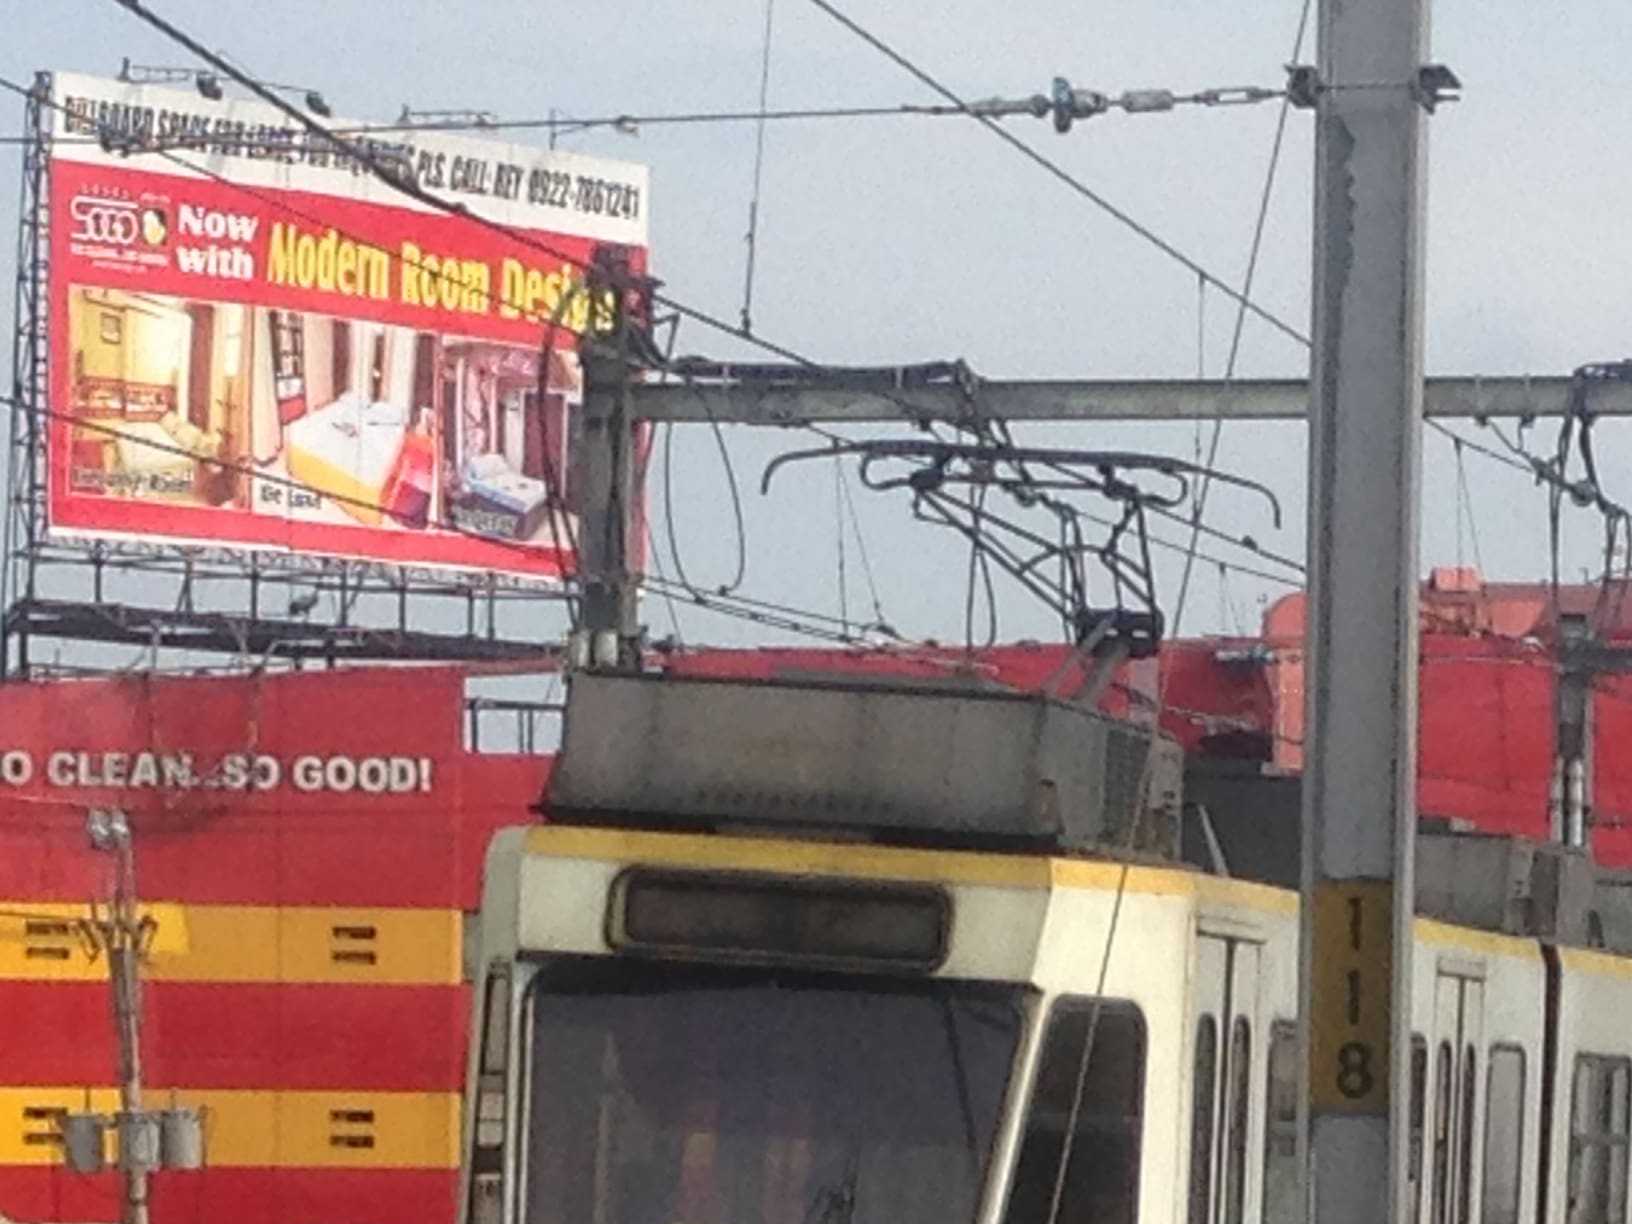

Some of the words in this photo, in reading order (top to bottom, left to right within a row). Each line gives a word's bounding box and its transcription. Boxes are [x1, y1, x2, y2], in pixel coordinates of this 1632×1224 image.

[178, 202, 259, 243] Now
[175, 245, 255, 281] with
[267, 222, 390, 300] Modern
[401, 241, 492, 314] Room
[292, 756, 432, 793] GOOD!
